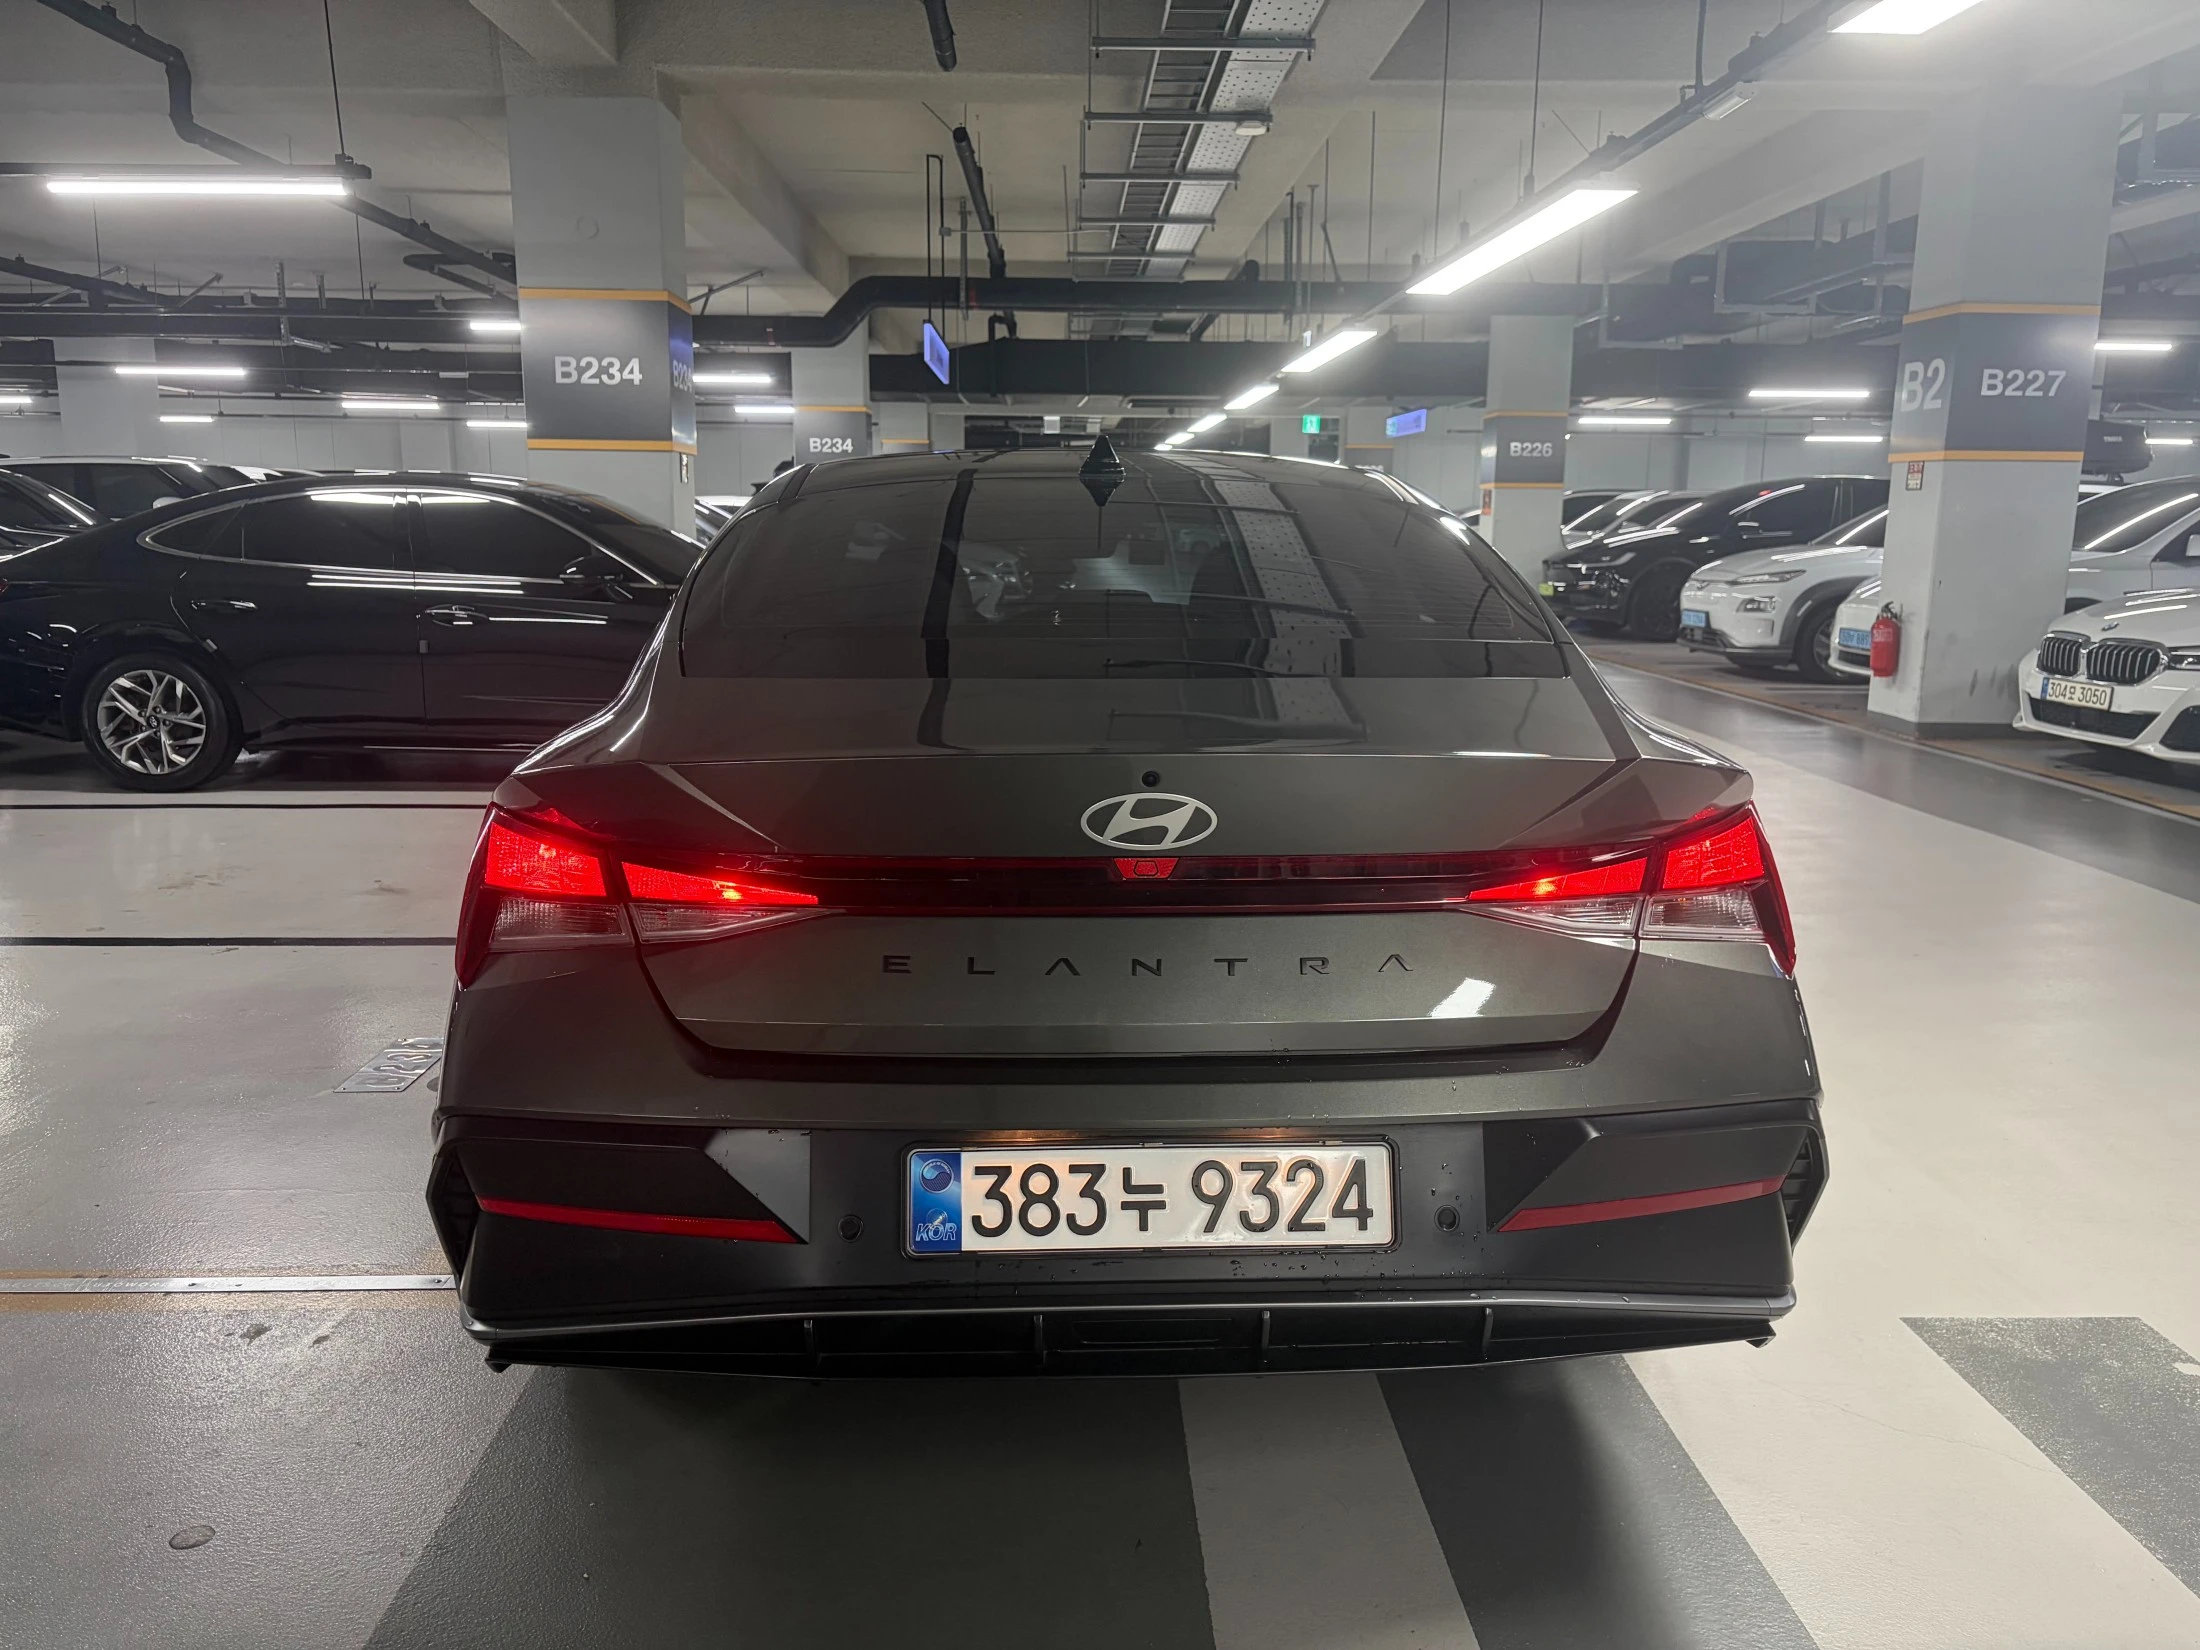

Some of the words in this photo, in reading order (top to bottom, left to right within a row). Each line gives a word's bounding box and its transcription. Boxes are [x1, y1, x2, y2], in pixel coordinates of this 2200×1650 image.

[554, 356, 642, 385] B234
[1980, 368, 2066, 397] B227
[1900, 357, 1946, 412] B2
[809, 437, 853, 453] B234
[1510, 441, 1553, 457] B226
[2077, 686, 2107, 706] 3050
[882, 953, 1414, 977] ELANTRA
[971, 1163, 1167, 1238] 383누
[1191, 1159, 1374, 1233] 9324
[915, 1222, 957, 1241] KOR
